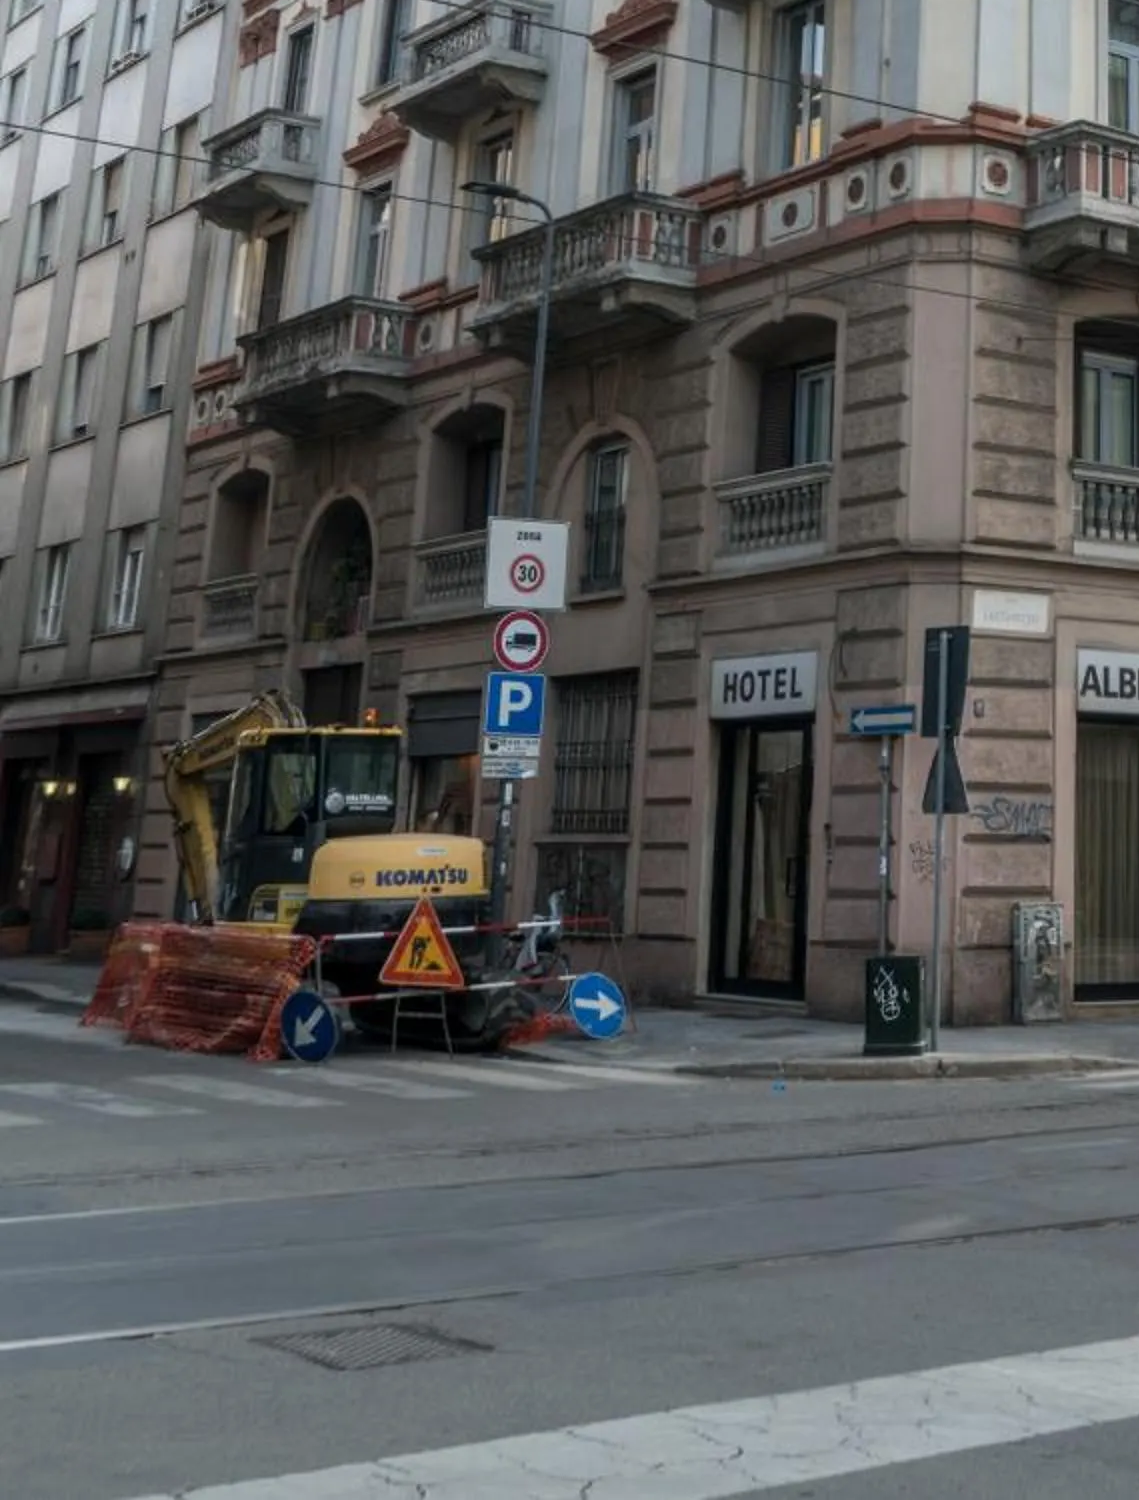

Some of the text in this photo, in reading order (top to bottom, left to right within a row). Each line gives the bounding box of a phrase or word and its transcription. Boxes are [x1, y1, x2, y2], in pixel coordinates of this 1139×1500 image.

[517, 564, 537, 582] 30
[723, 666, 803, 704] HOTEL
[498, 680, 533, 727] P
[375, 867, 468, 888] KOMATSU
